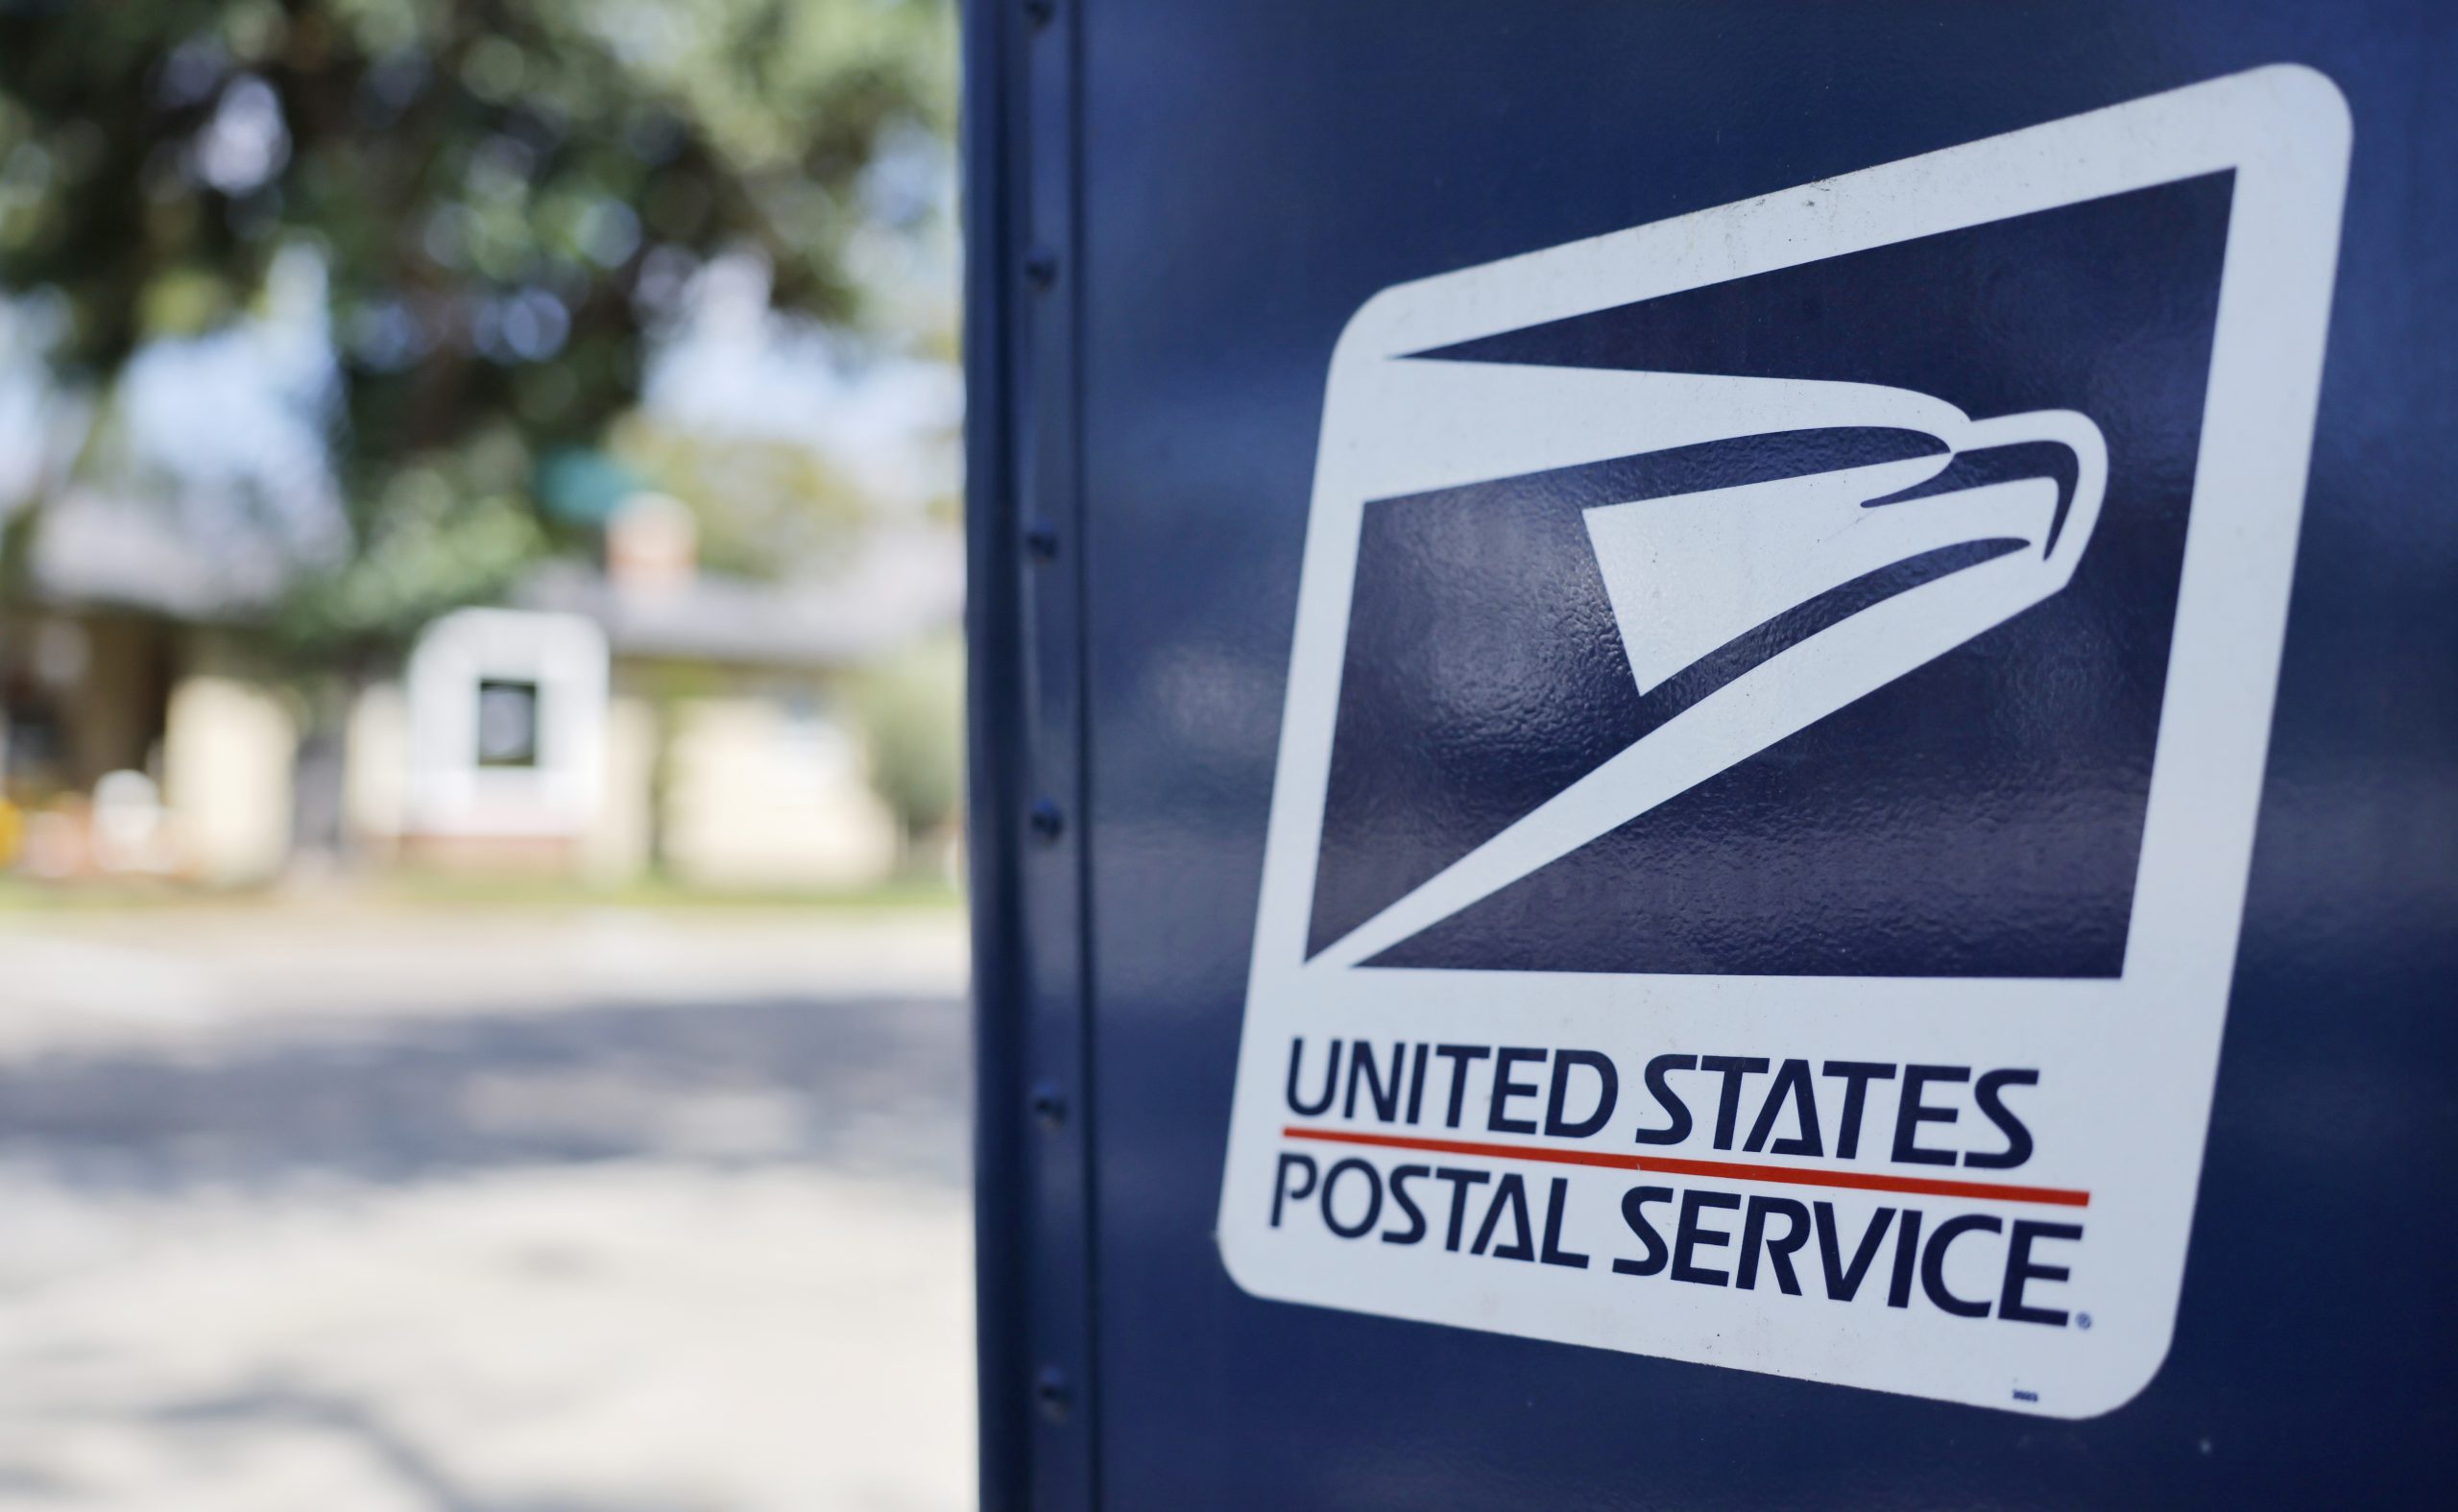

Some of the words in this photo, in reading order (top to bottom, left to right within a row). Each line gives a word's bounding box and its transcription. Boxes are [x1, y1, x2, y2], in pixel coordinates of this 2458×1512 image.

[1286, 1037, 1619, 1140] UNITED
[1634, 1053, 2039, 1169] STATES
[1269, 1152, 1590, 1270] POSTAL
[1612, 1186, 2084, 1328] SERVICE
